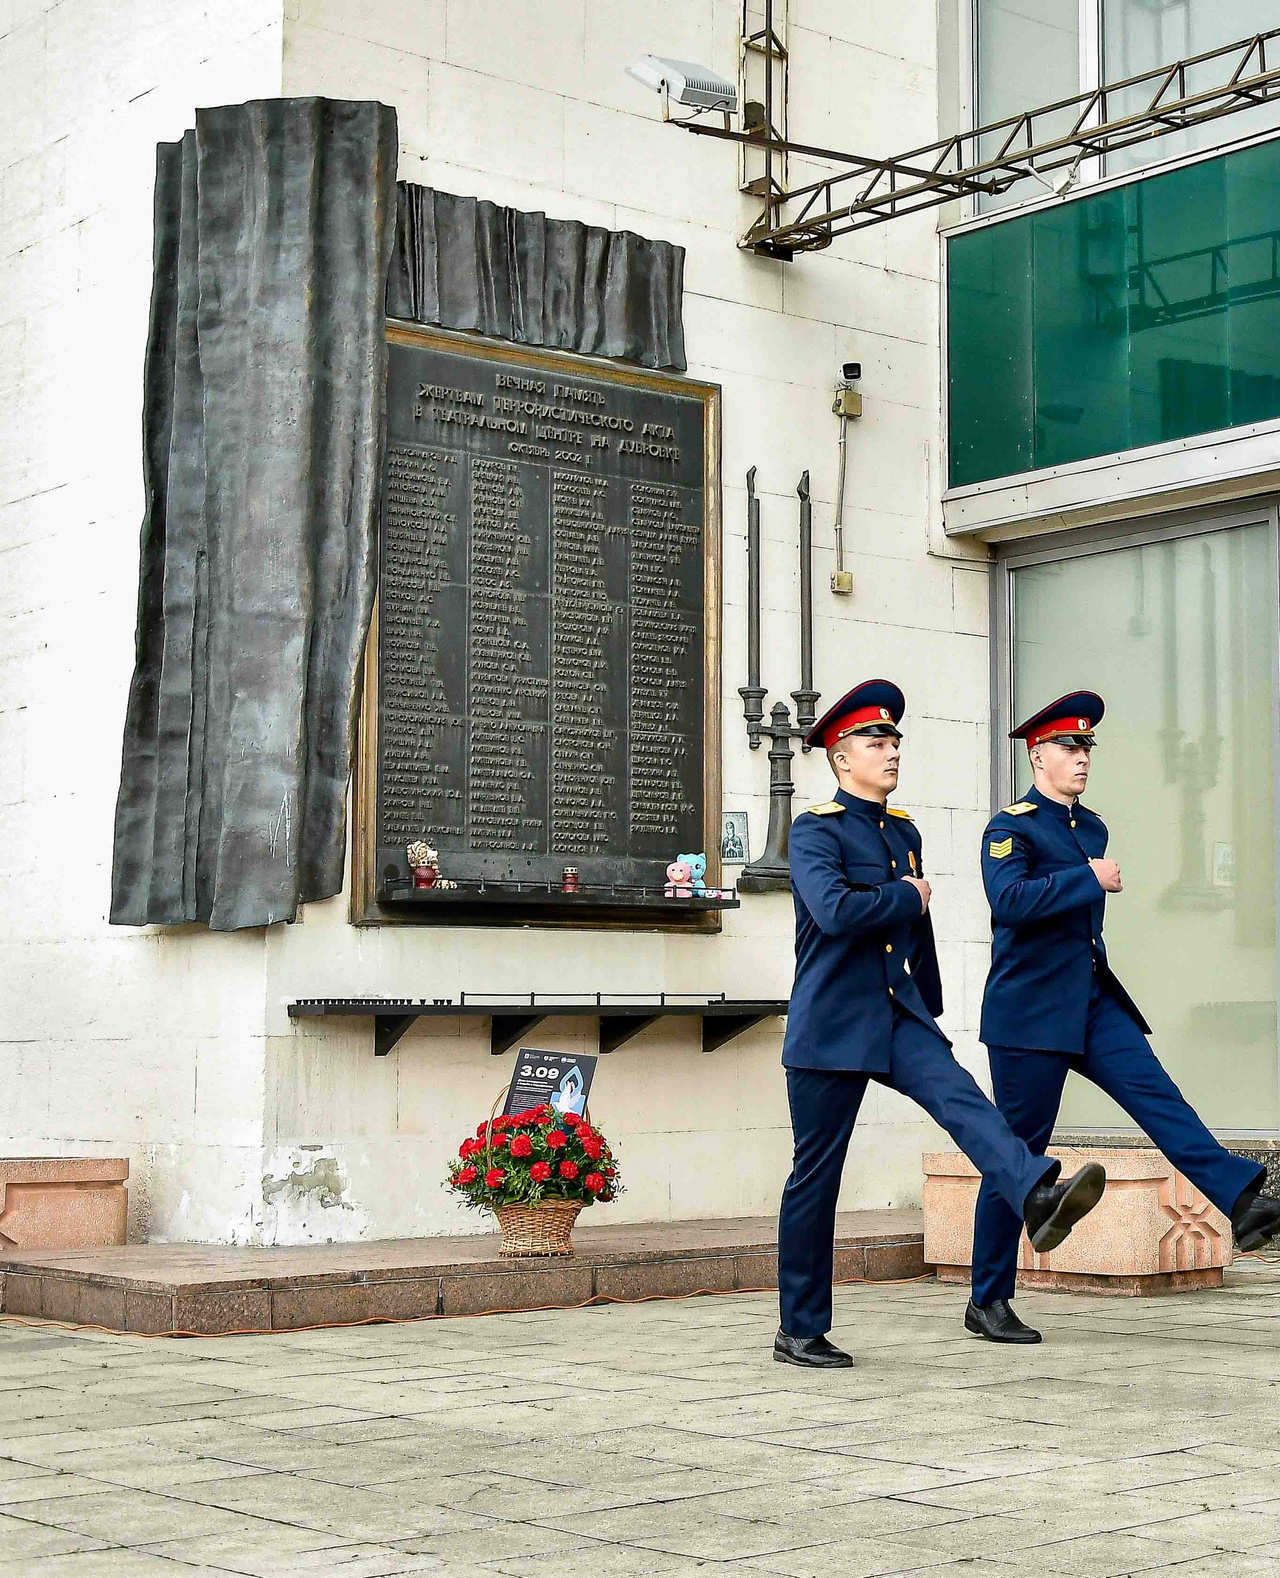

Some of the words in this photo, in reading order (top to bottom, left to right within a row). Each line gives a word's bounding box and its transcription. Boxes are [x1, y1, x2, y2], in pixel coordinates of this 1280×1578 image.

[495, 374, 546, 394] ВЕЧНАЯ
[553, 384, 605, 405] ПАМЯТЬ
[418, 382, 484, 407] ЖЕРТВАМ
[493, 396, 634, 432] ТЕРРОРИСТИЧЕСКОГО
[642, 423, 676, 440] АКТА
[413, 405, 423, 418] В
[432, 406, 527, 435] ТЕАТРАЛЬНОМ
[535, 424, 582, 445] ЦЕНТРЕ
[590, 434, 610, 449] НА
[617, 439, 681, 460] ДУБРОВКЕ
[507, 442, 550, 458] ОКТЯБРЬ
[554, 450, 582, 464] 2002
[520, 1065, 560, 1080] 3.09
